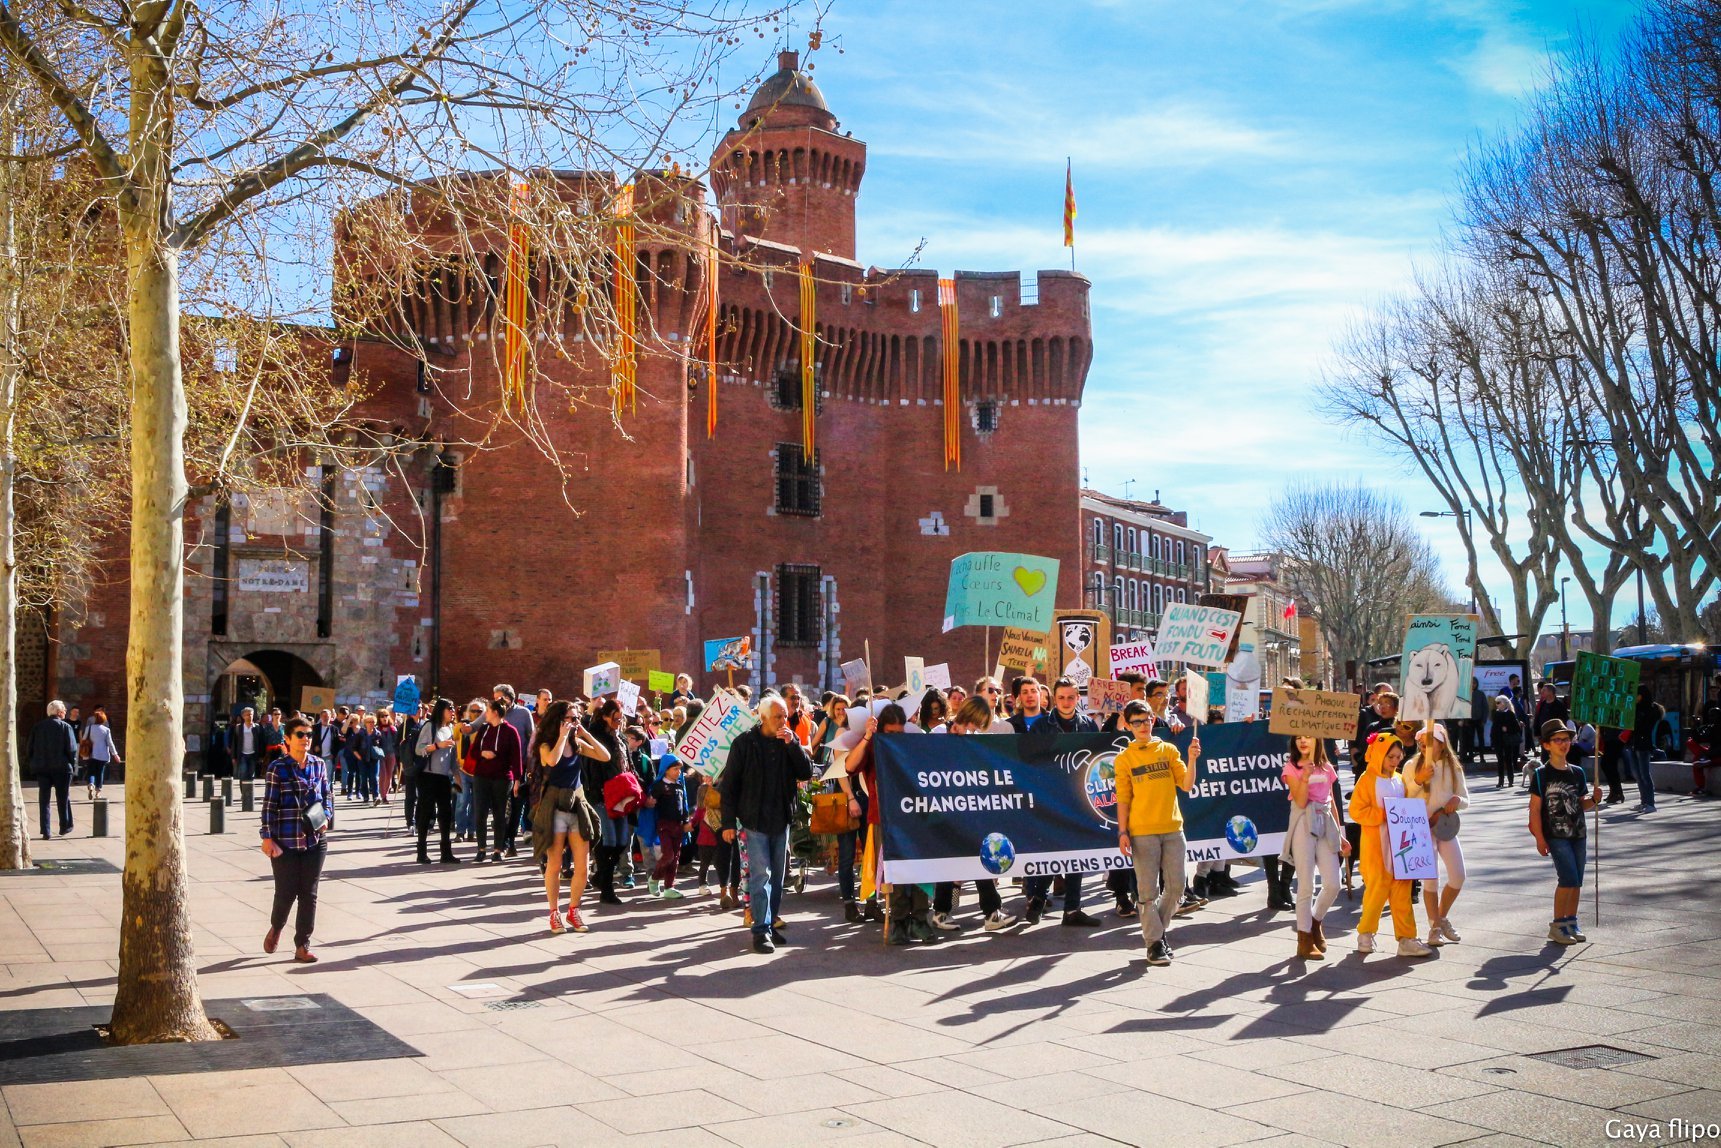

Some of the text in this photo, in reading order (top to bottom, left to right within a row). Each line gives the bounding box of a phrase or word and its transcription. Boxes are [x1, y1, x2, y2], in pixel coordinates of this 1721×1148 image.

[995, 601, 1041, 622] Climat
[1169, 607, 1239, 628] QUAND C'EST
[1167, 624, 1205, 640] FONDU
[1409, 618, 1471, 631] ainsi Fond
[1451, 633, 1471, 643] Fond
[1111, 646, 1149, 662] BREAK
[1181, 640, 1227, 661] FOUTU
[1484, 670, 1506, 678] free
[1290, 719, 1340, 731] CLIMATIQUE
[694, 705, 741, 766] VOUS POUR
[704, 756, 722, 776] LA
[1206, 752, 1291, 774] RELEVONS
[917, 769, 1014, 788] SOYONS LE
[1085, 778, 1116, 794] CLIM
[1188, 776, 1290, 799] DÉFI CLIMA
[900, 793, 1024, 813] CHANGEMENT
[1093, 792, 1118, 808] ALA
[1399, 830, 1417, 850] LA
[1186, 847, 1221, 862] IMAT
[1394, 846, 1432, 874] TERRE
[1024, 855, 1134, 875] CITOYENS POU
